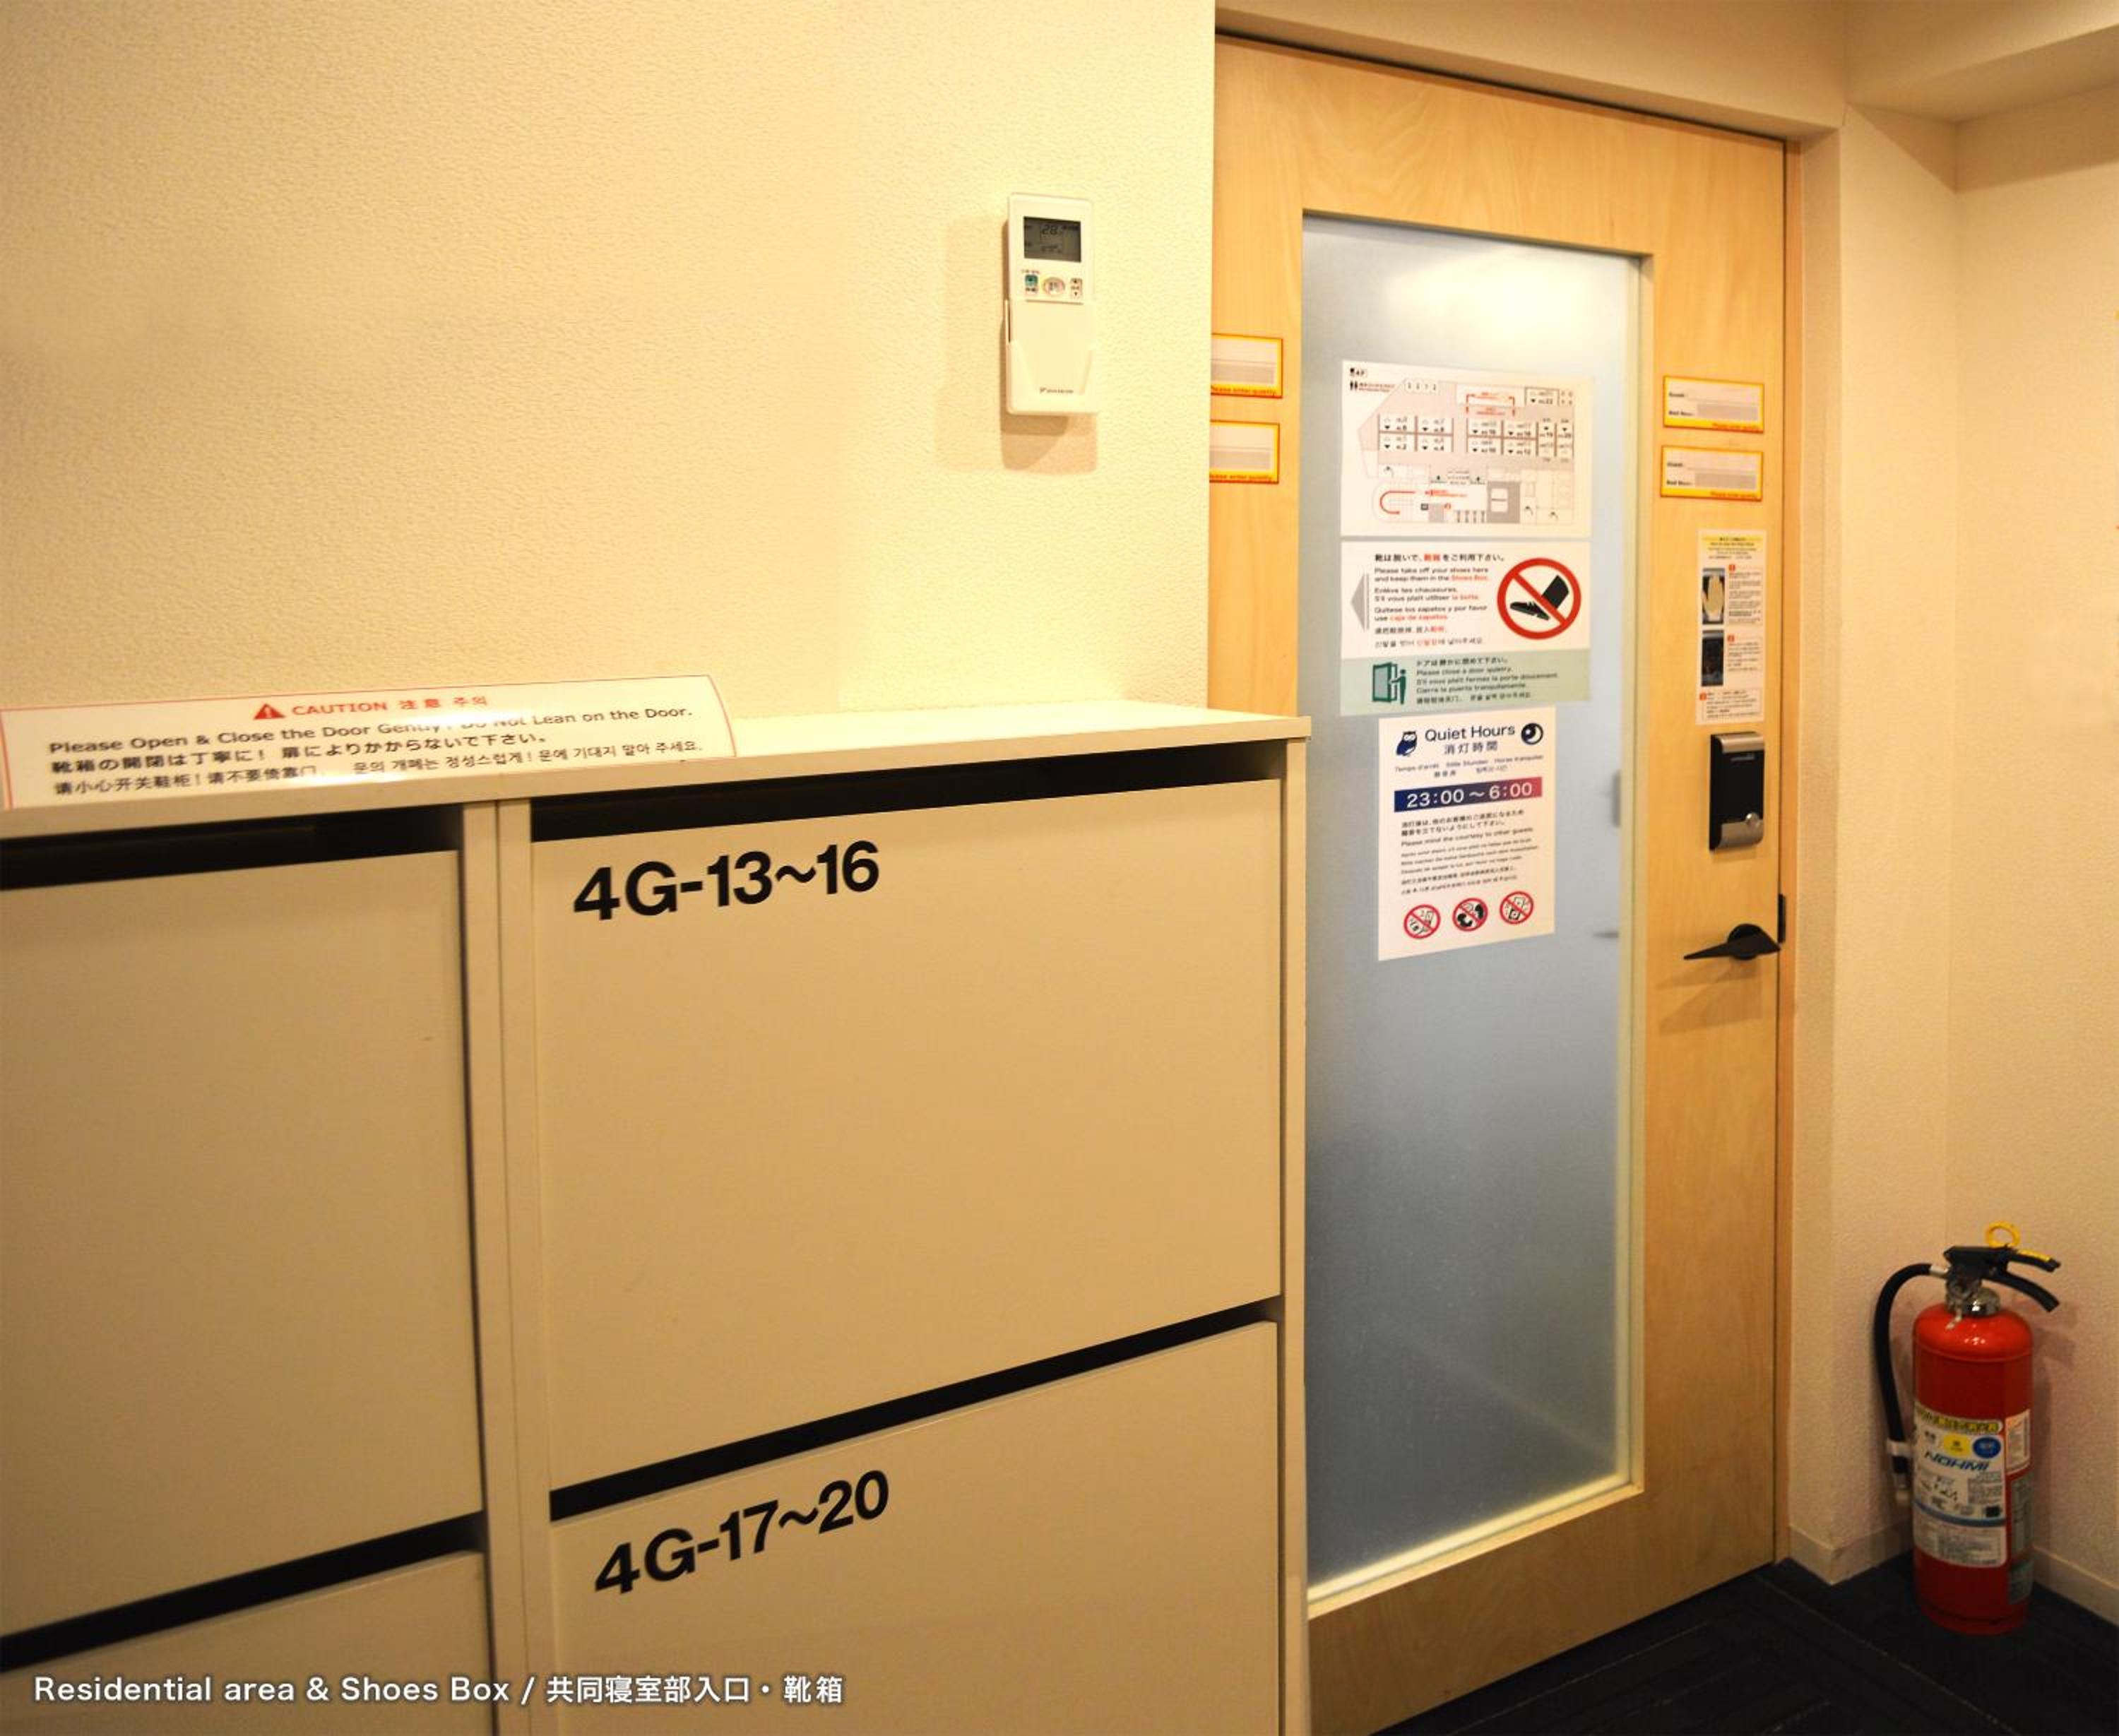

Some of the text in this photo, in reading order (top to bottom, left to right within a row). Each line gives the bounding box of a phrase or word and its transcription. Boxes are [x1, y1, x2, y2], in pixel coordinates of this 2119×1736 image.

[292, 701, 387, 715] CAUTION
[49, 740, 124, 754] Please
[130, 736, 188, 750] Open
[196, 735, 211, 744] &
[218, 731, 275, 744] Close
[281, 729, 316, 740] the
[322, 726, 372, 738] Door
[533, 714, 577, 725] Lean
[582, 713, 604, 722] on
[610, 709, 640, 720] the
[645, 707, 693, 719] Door.
[1425, 725, 1515, 742] Quiet Hours
[1407, 789, 1464, 808] 23:00
[1489, 783, 1532, 799] 6:00
[574, 840, 879, 920] 4G-13~16
[595, 1470, 889, 1594] 4G-17~20
